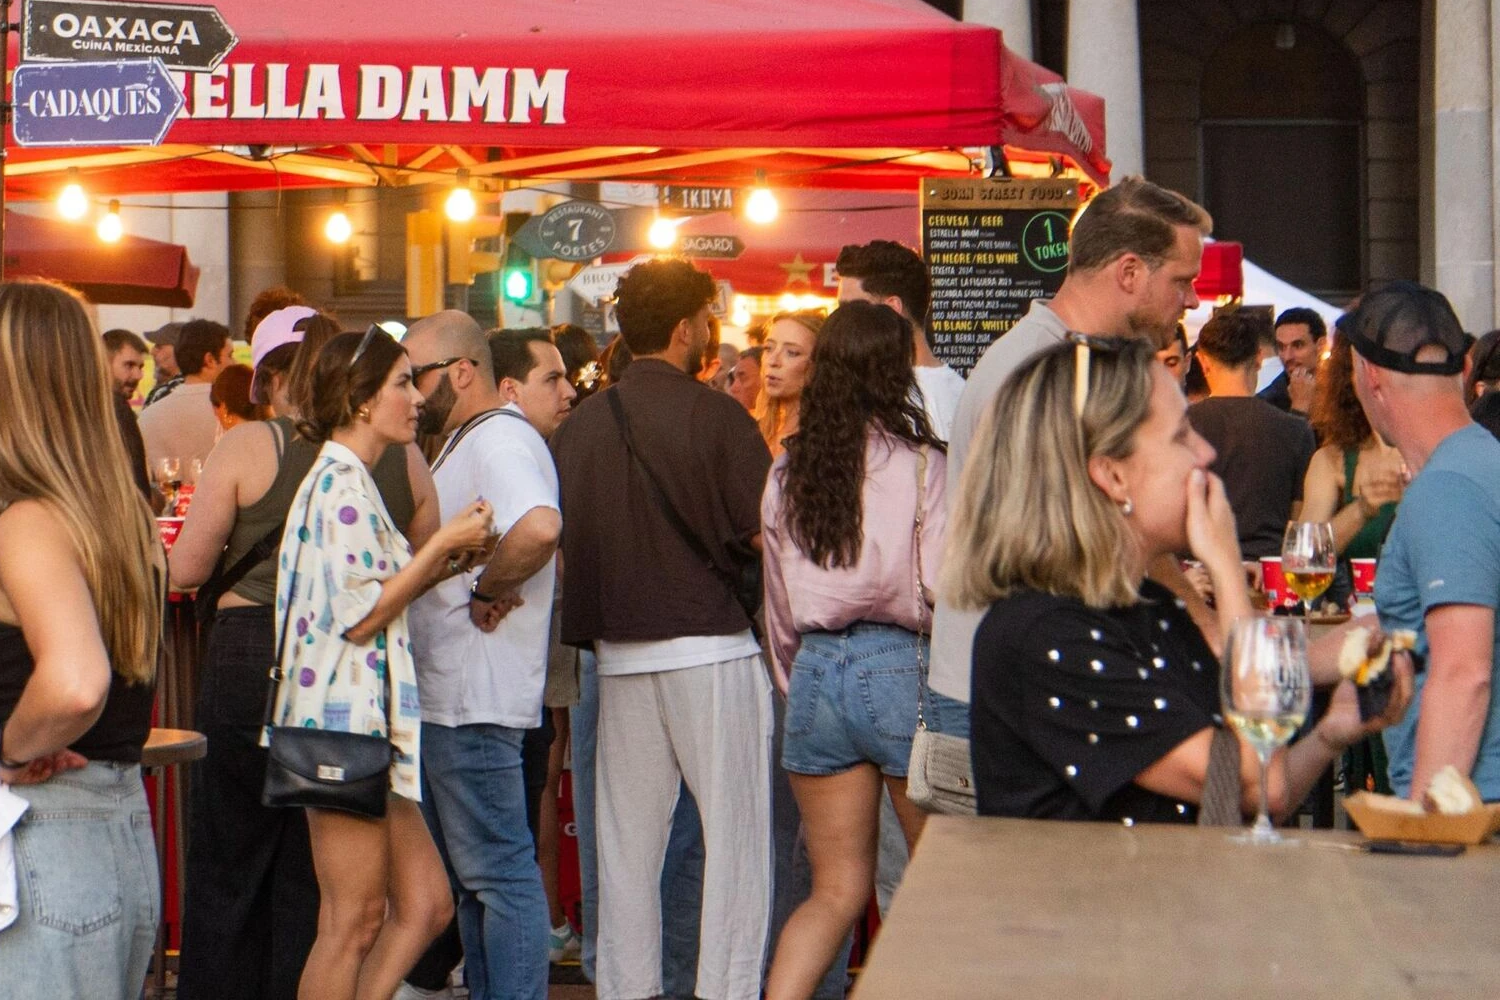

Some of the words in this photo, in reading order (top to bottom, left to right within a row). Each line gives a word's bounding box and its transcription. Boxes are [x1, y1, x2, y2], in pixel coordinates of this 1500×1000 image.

[53, 12, 200, 46] OAXACA
[177, 63, 346, 120] ELLA
[359, 63, 570, 125] DAMM
[980, 187, 1025, 200] STREET
[547, 205, 605, 224] RESTAURANT
[928, 215, 970, 227] CERVESA
[981, 215, 1004, 227] BEER
[568, 219, 583, 242] 7
[929, 228, 959, 238] ESTRELLA
[1044, 218, 1054, 243] 1
[552, 238, 605, 256] PORTES
[683, 237, 733, 252] SAGARDI
[930, 240, 958, 250] COMPLOT
[1034, 242, 1070, 261] TOKEN
[930, 252, 940, 264] VI
[942, 252, 972, 264] NEGRE
[996, 252, 1019, 264] WINE
[932, 320, 942, 330] VI
[982, 320, 1010, 331] WHITE
